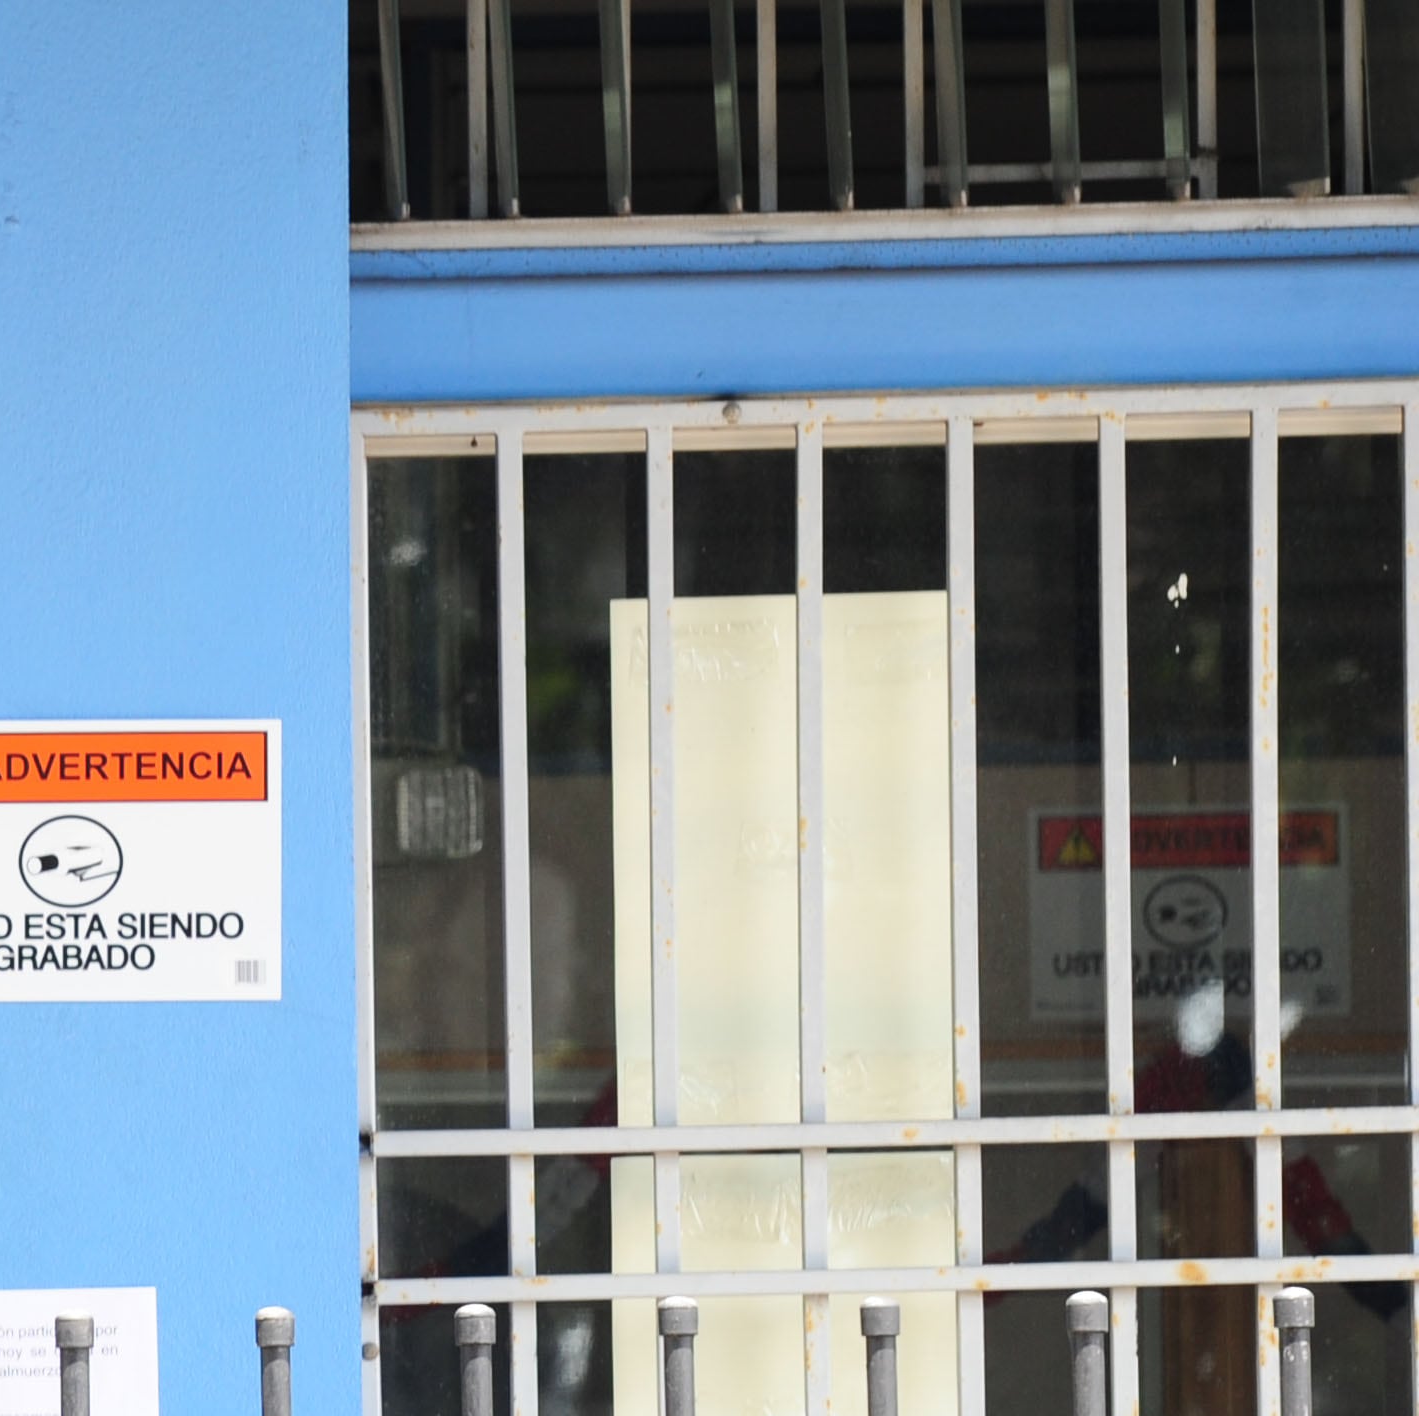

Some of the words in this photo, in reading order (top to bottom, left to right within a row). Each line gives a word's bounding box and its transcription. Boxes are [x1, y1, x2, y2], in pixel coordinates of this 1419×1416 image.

[23, 913, 107, 940] ESTA
[116, 912, 244, 940] SIENDO
[29, 1347, 47, 1359] se
[101, 1346, 119, 1357] en
